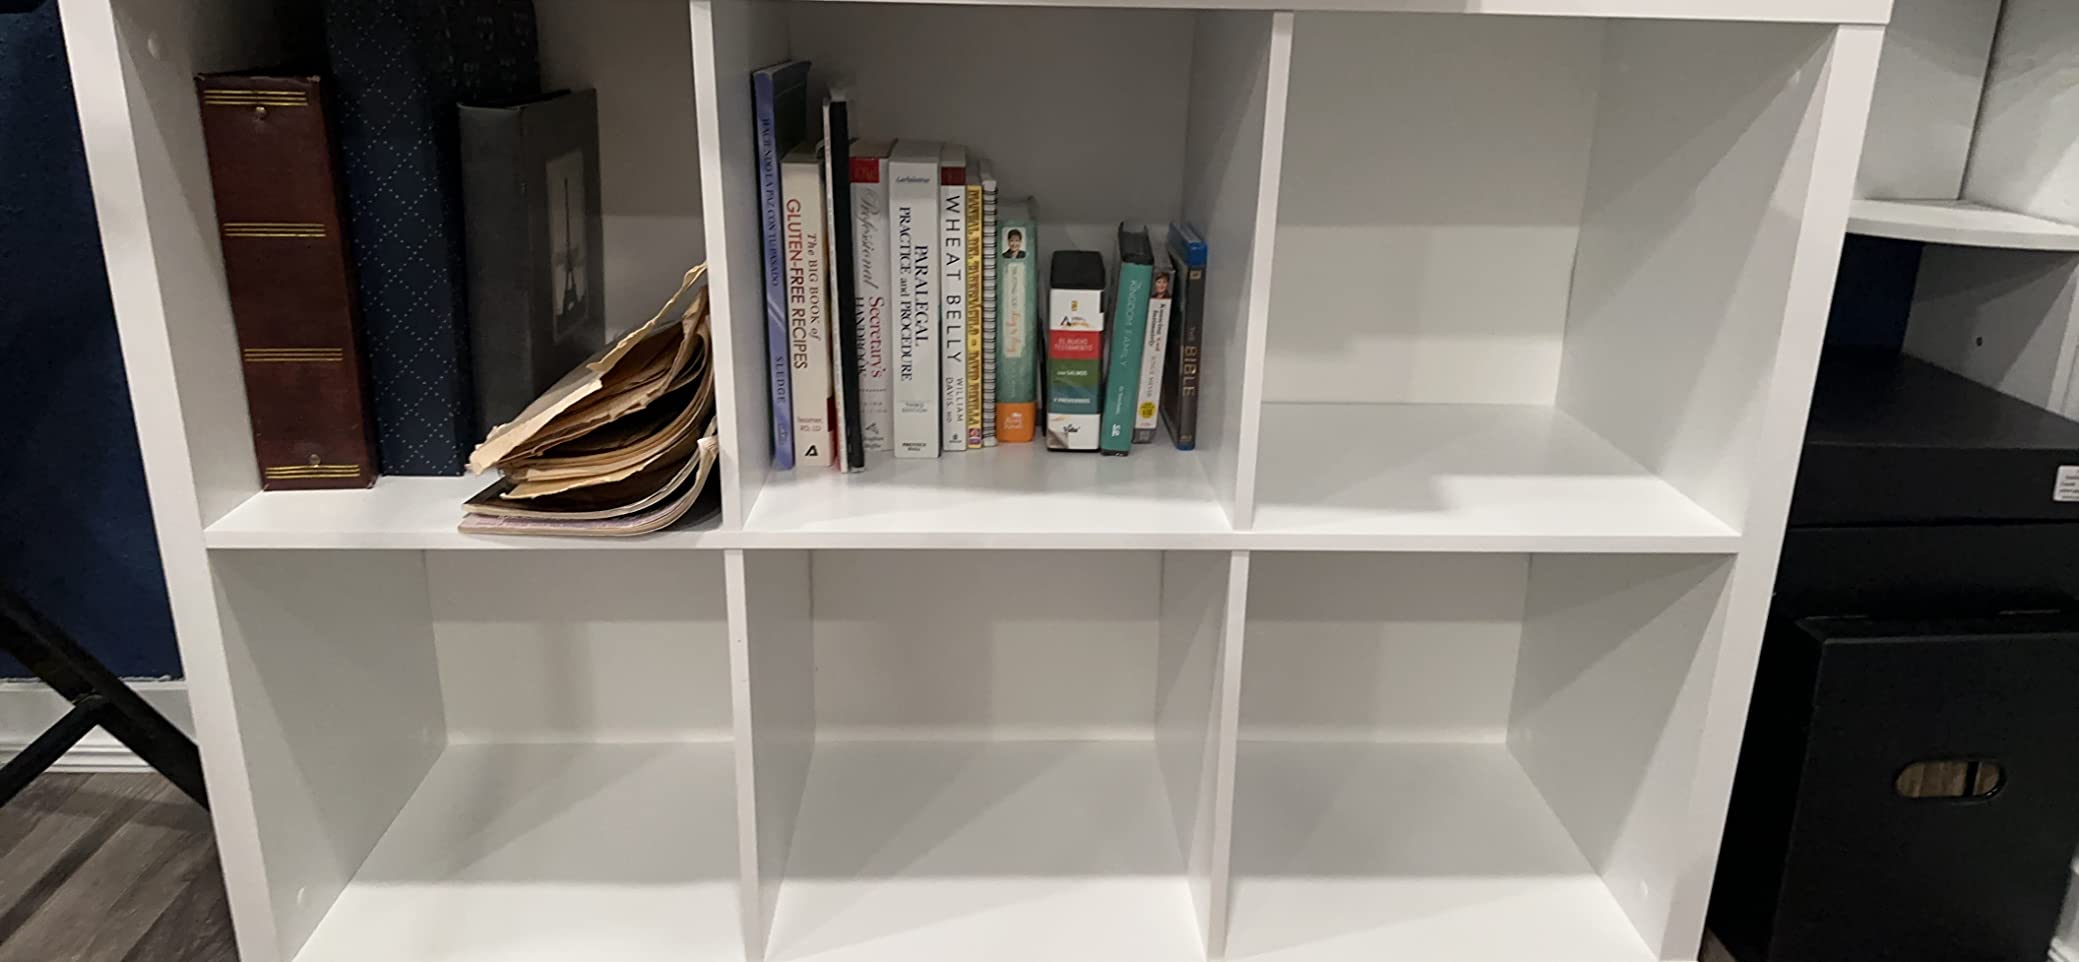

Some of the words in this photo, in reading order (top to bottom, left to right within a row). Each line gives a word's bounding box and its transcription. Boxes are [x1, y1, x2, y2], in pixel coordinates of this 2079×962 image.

[767, 209, 776, 231] CON
[807, 233, 817, 256] The
[856, 188, 880, 289] Professional
[899, 206, 912, 275] PRACTICE
[946, 195, 961, 280] WHEAT
[769, 248, 779, 287] PASADO
[786, 198, 805, 305] GLUTEN-FREE
[808, 260, 818, 283] BIG
[809, 287, 821, 324] BOOK
[900, 277, 911, 298] and
[914, 245, 929, 348] PARALEGAL
[791, 308, 808, 370] RECIPES
[809, 327, 822, 342] of
[869, 296, 887, 379] Secretary's
[900, 300, 913, 382] PROCEDURE
[946, 294, 962, 362] BELLY
[775, 356, 786, 404] SLEDGE
[1183, 346, 1198, 397] BIBLE
[955, 377, 965, 423] WILLIAM
